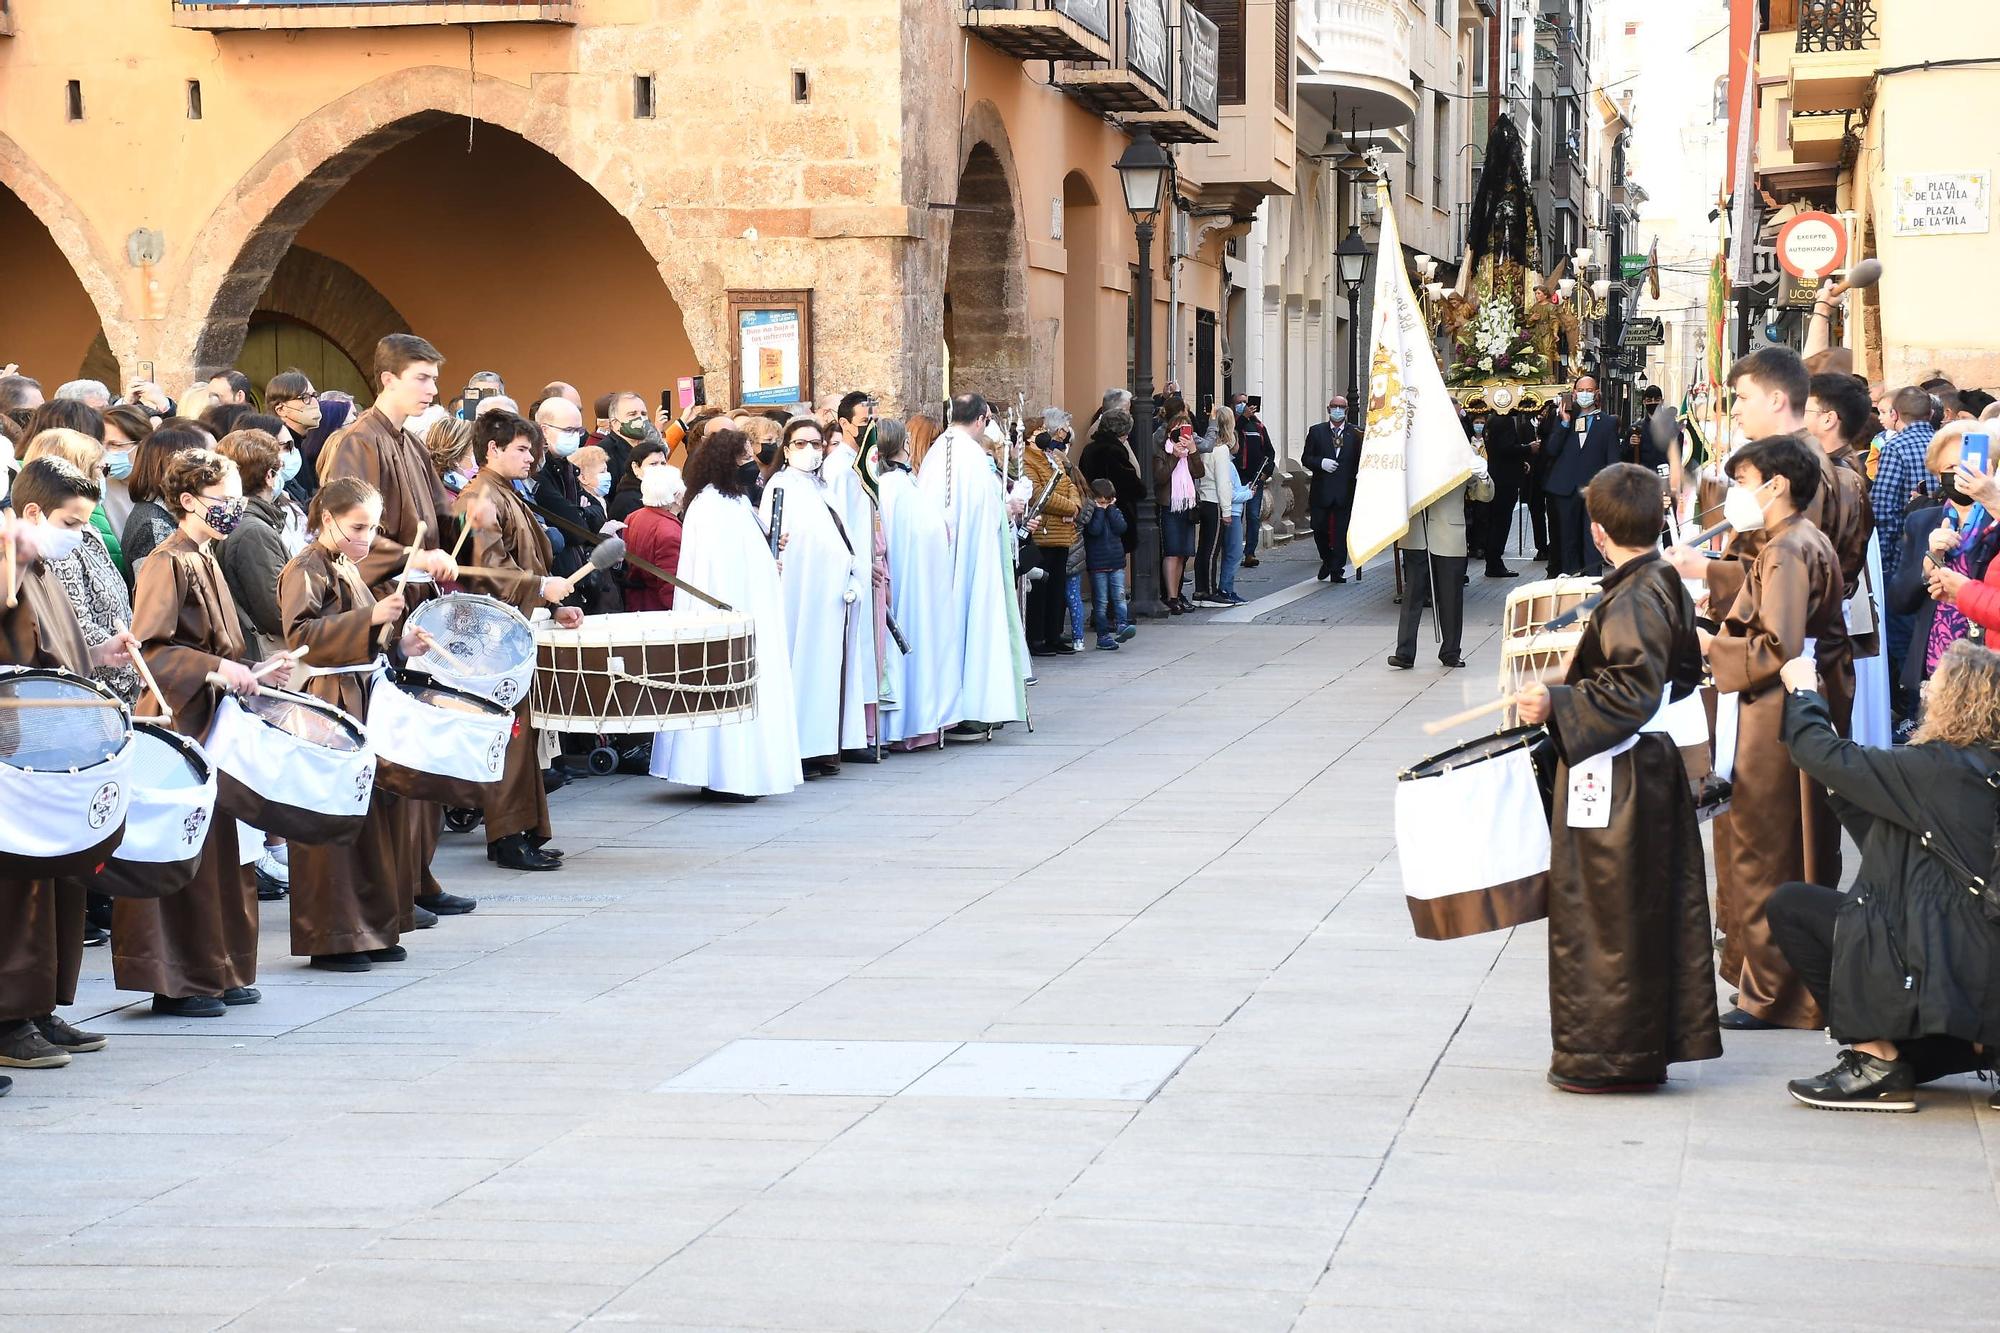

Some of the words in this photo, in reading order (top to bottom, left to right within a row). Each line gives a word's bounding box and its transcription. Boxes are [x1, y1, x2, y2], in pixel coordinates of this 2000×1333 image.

[1915, 192, 1927, 201] DE
[1931, 192, 1942, 200] LA
[1946, 190, 1968, 200] VILA
[1926, 206, 1956, 216] PLAZA
[1913, 218, 1924, 227] DE
[1929, 218, 1941, 226] LA
[1946, 216, 1967, 225] VILA
